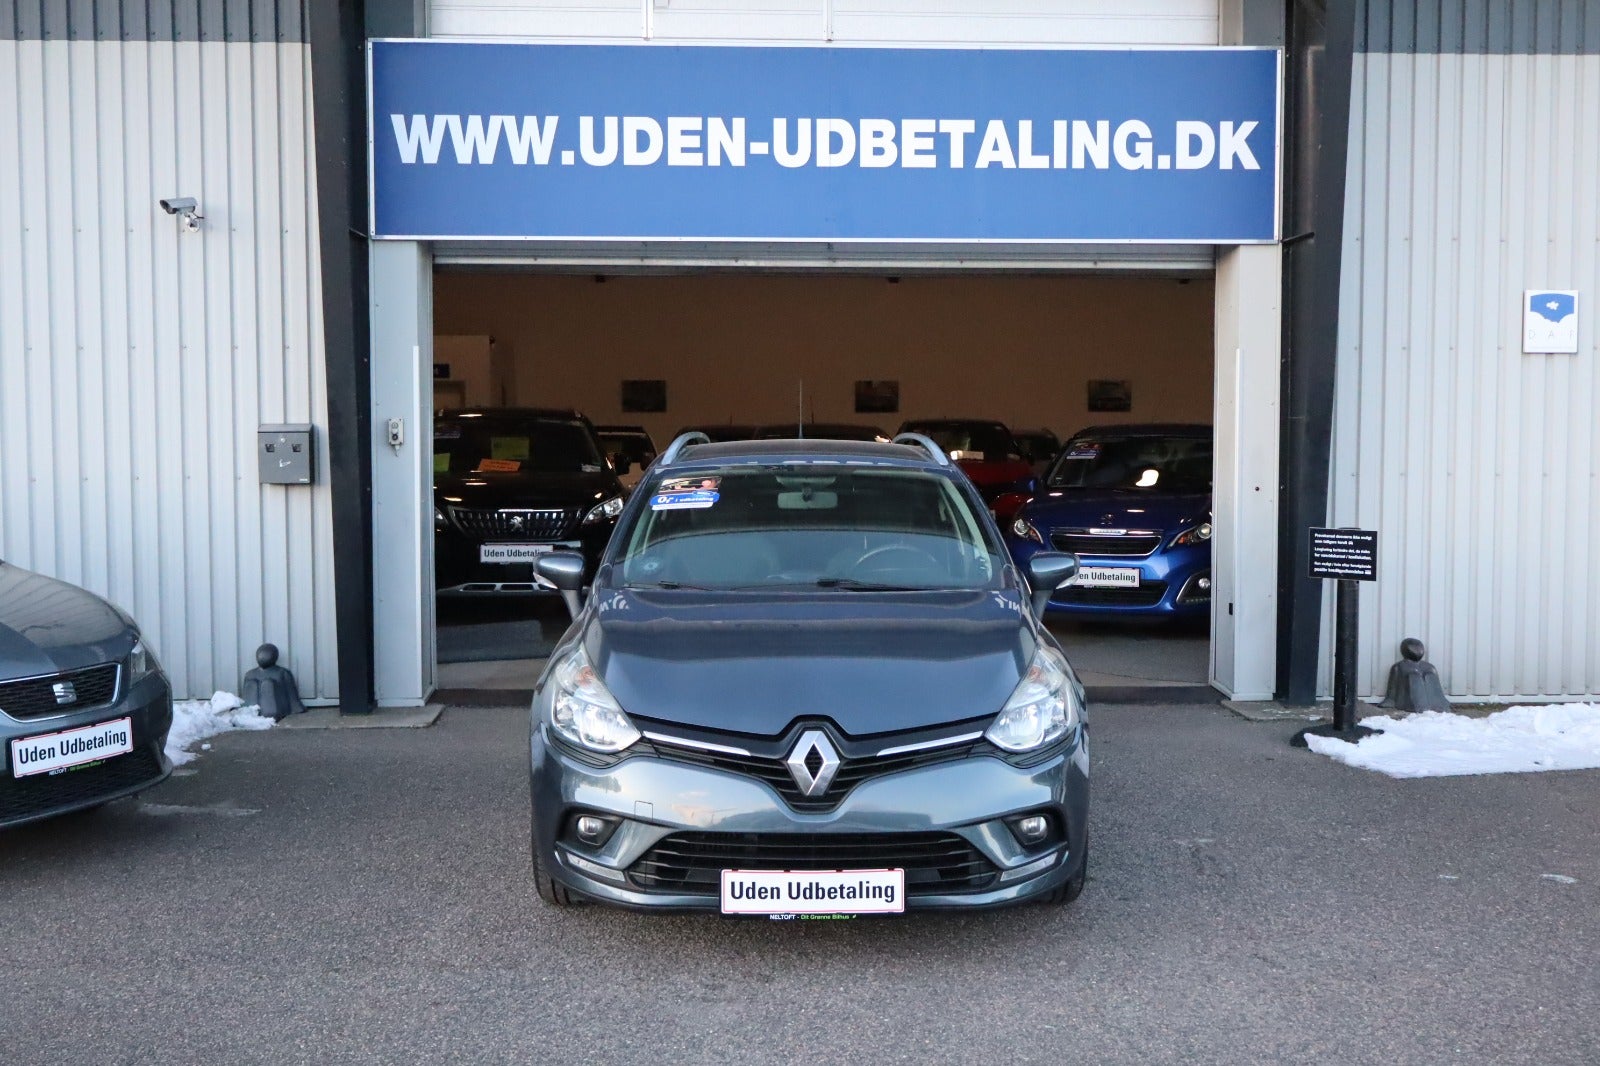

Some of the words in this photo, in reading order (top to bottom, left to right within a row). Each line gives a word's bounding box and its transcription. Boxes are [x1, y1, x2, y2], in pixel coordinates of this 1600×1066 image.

[389, 114, 1261, 170] WWW.UDEN-UDBETALING.DK
[484, 549, 505, 558] Uden
[1091, 571, 1136, 583] Udbetaling
[19, 745, 56, 765] Uden
[60, 730, 127, 756] Udbetaling
[730, 881, 781, 900] Uden
[788, 880, 895, 903] Udbetaling
